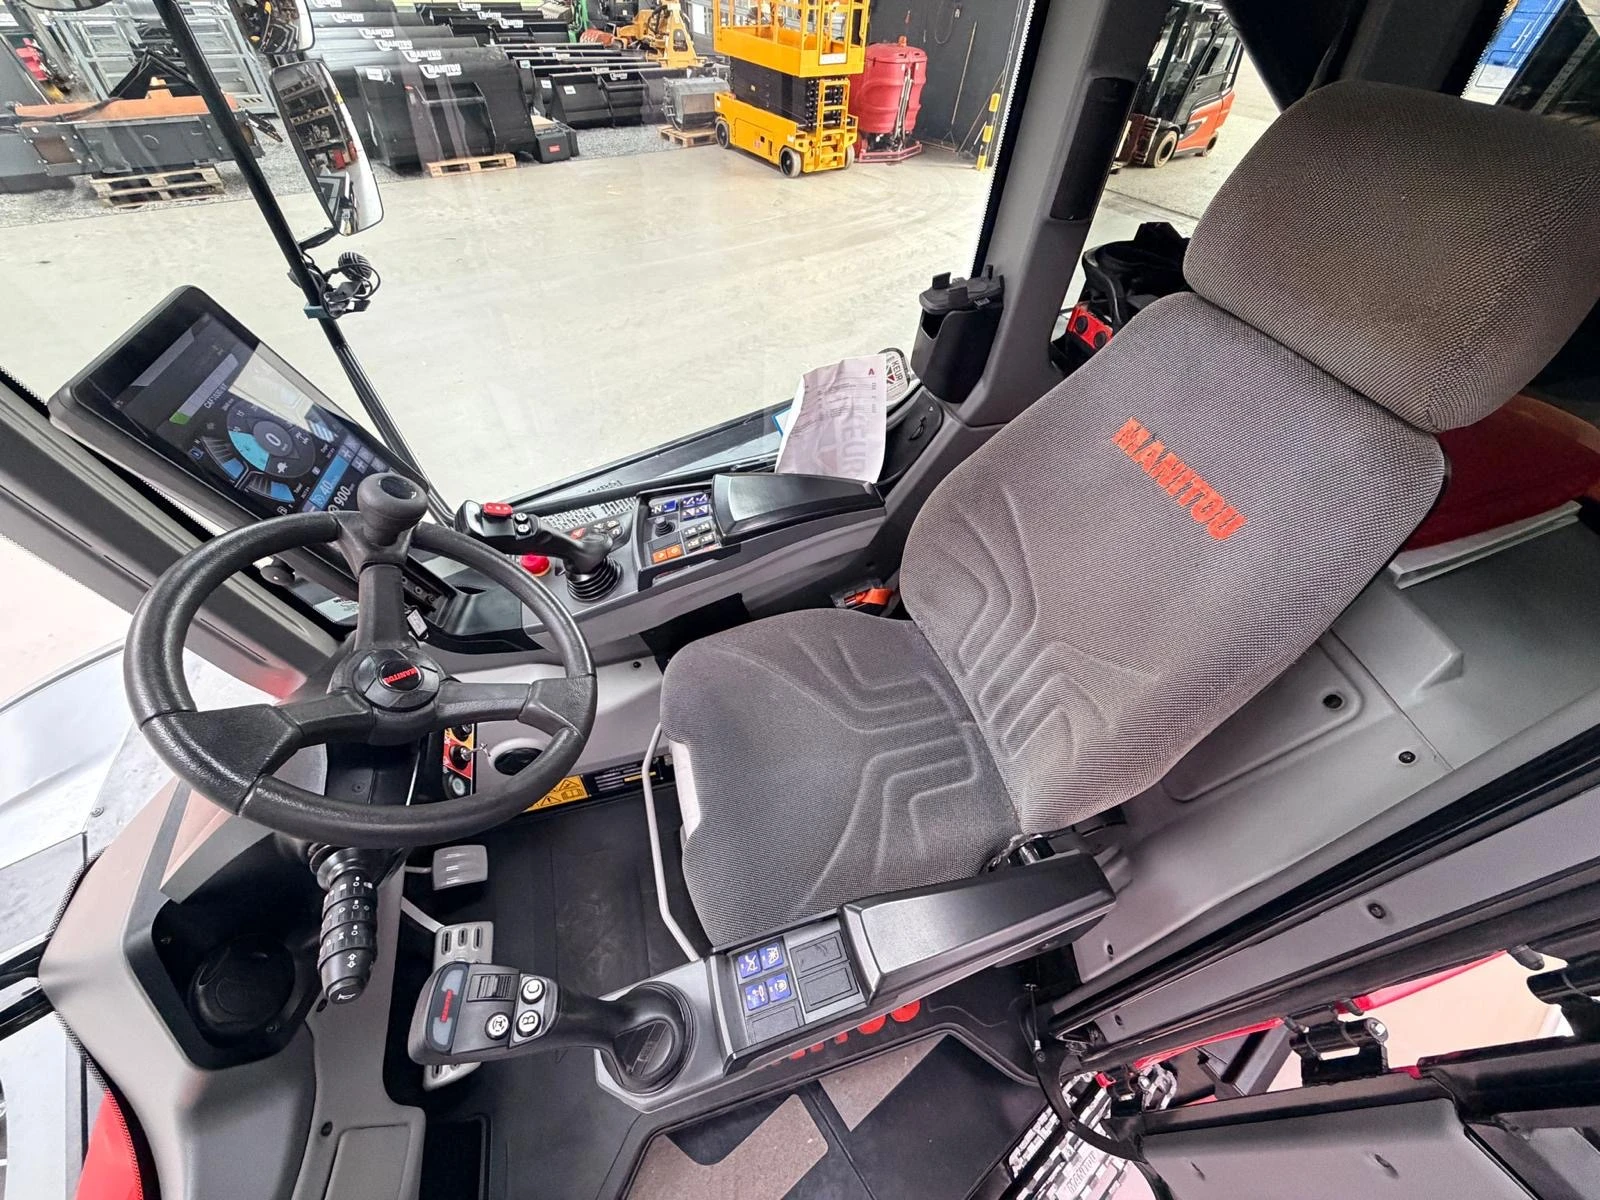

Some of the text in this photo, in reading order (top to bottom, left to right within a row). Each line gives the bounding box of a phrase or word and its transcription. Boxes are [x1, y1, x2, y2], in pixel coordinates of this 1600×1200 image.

[405, 50, 441, 60] MANITOU
[423, 63, 462, 75] MANITOU
[891, 360, 904, 381] KEUR
[265, 432, 281, 447] 0
[1111, 416, 1248, 541] MANITOU
[320, 480, 333, 496] 40
[333, 485, 351, 506] 900
[526, 983, 540, 994] C
[521, 1014, 536, 1026] B
